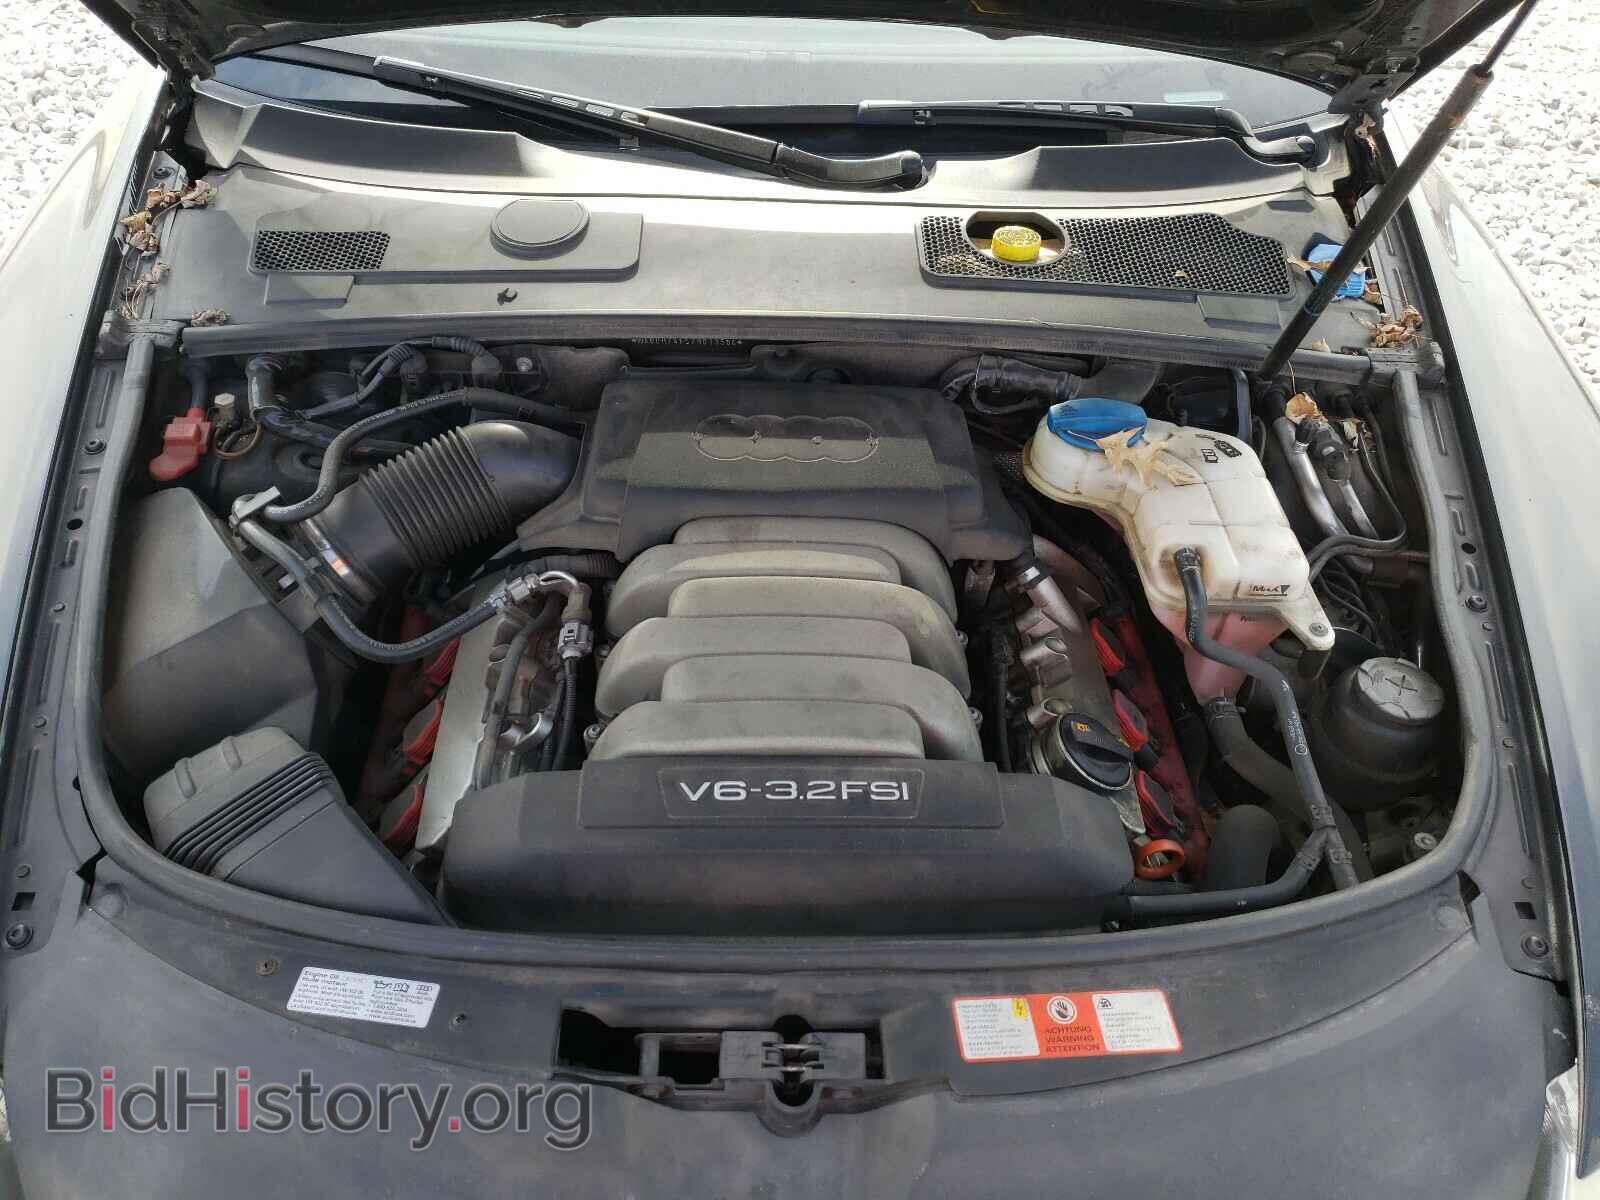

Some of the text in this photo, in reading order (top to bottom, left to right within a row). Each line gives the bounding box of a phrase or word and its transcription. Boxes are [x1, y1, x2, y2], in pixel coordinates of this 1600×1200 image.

[679, 780, 910, 801] V6-3.2FSI
[1046, 1025, 1092, 1033] ACHTUNG
[1047, 1034, 1094, 1042] WARNING
[1045, 1043, 1100, 1052] ATTENTION
